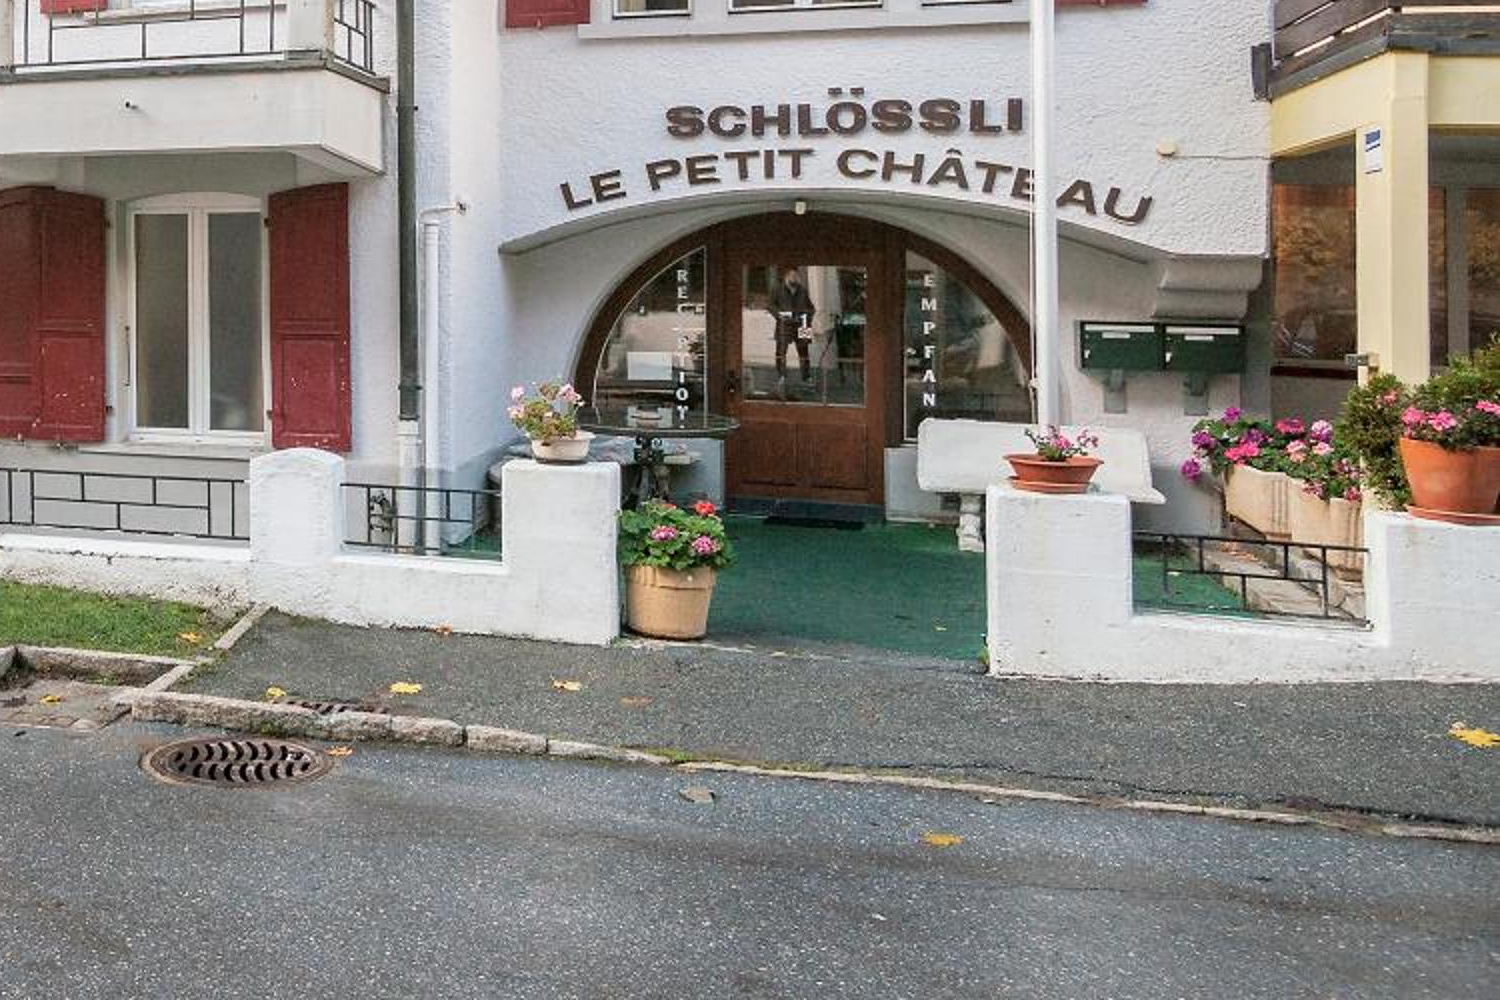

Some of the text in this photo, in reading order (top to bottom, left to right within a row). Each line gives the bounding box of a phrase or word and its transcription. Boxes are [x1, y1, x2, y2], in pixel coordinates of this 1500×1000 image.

[665, 87, 1024, 140] SCHLÖSSLI
[560, 148, 1154, 226] LE PETIT CHÂTEAU
[921, 273, 937, 408] EMPFAN
